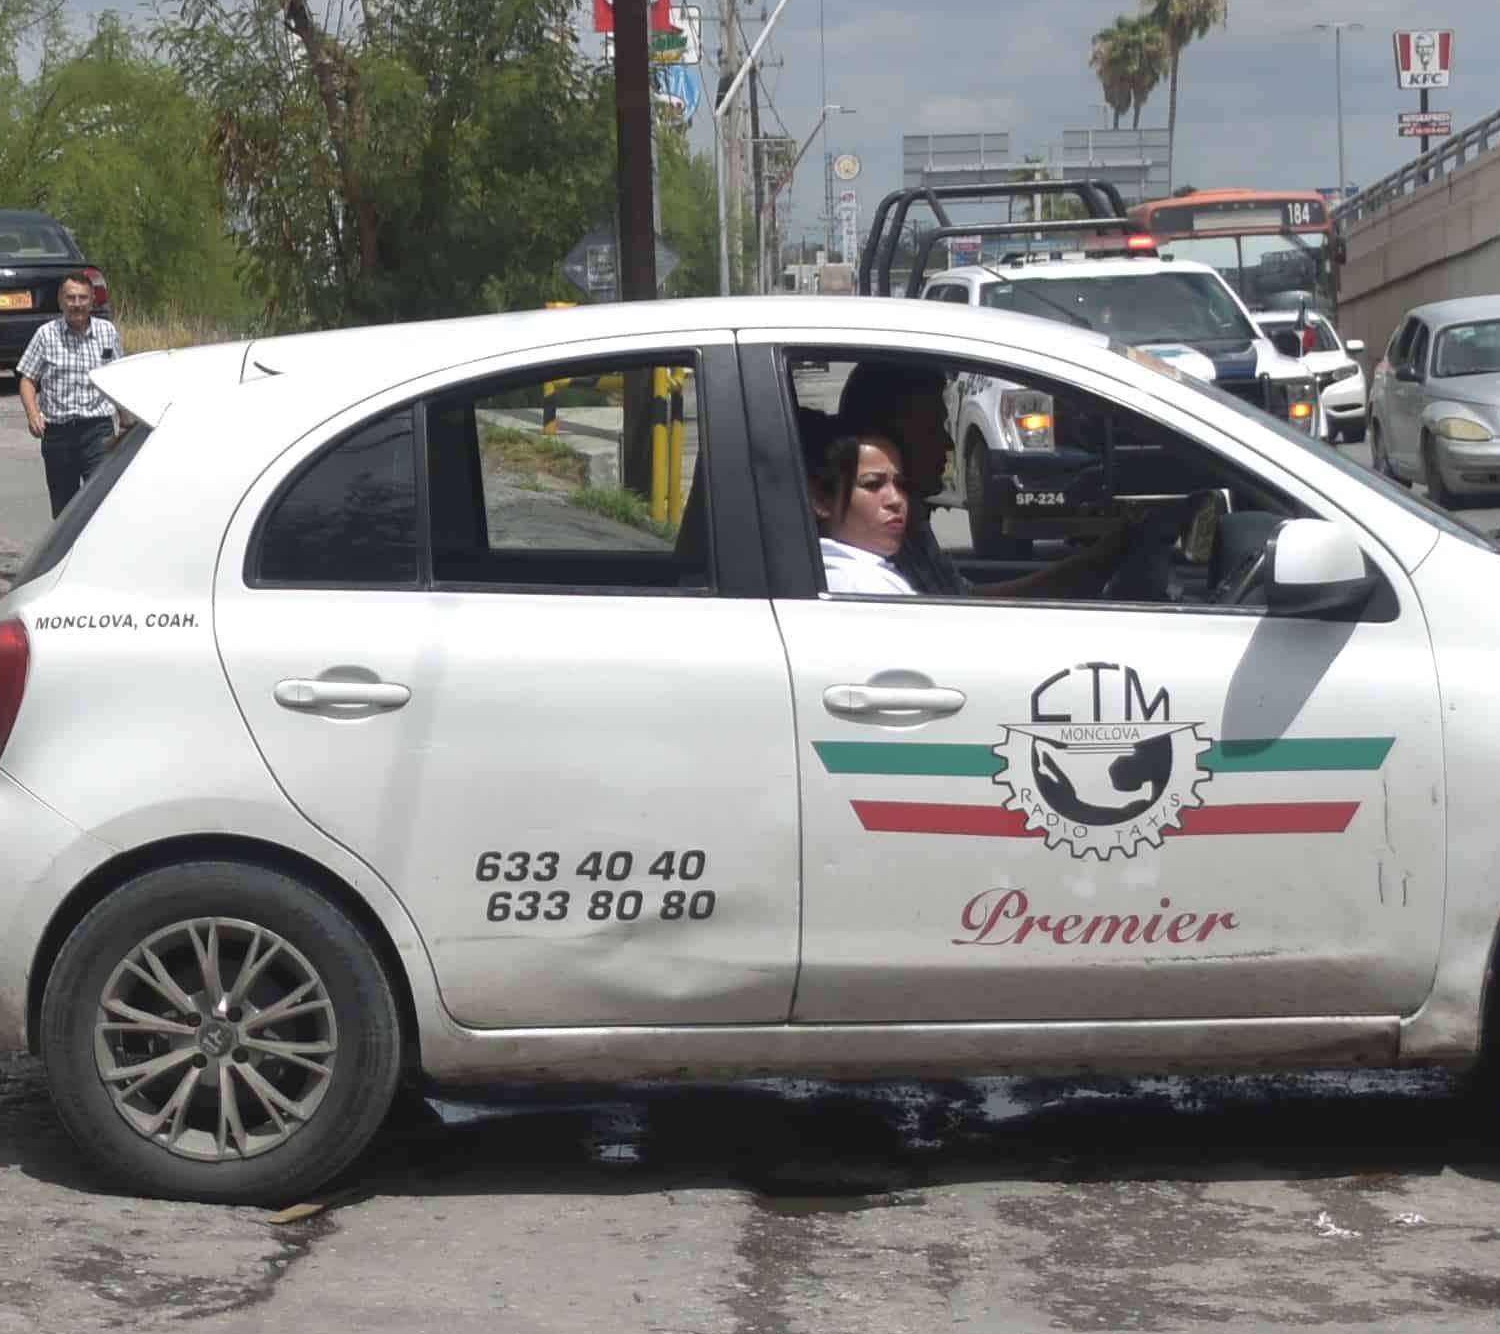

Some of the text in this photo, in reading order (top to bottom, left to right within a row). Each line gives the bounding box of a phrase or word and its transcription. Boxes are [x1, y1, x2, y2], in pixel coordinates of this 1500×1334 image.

[1408, 73, 1442, 85] KFC
[1288, 202, 1310, 225] 184
[1015, 492, 1065, 505] SP-224
[35, 613, 199, 631] MONCLOVA, COAH.
[1031, 661, 1169, 723] CTM
[1060, 727, 1141, 741] MONCLOVA
[1020, 787, 1180, 844] RADIO TAXIS
[475, 850, 706, 882] 633 40 40
[486, 890, 716, 922] 633 80 80
[951, 887, 1240, 945] Premier
